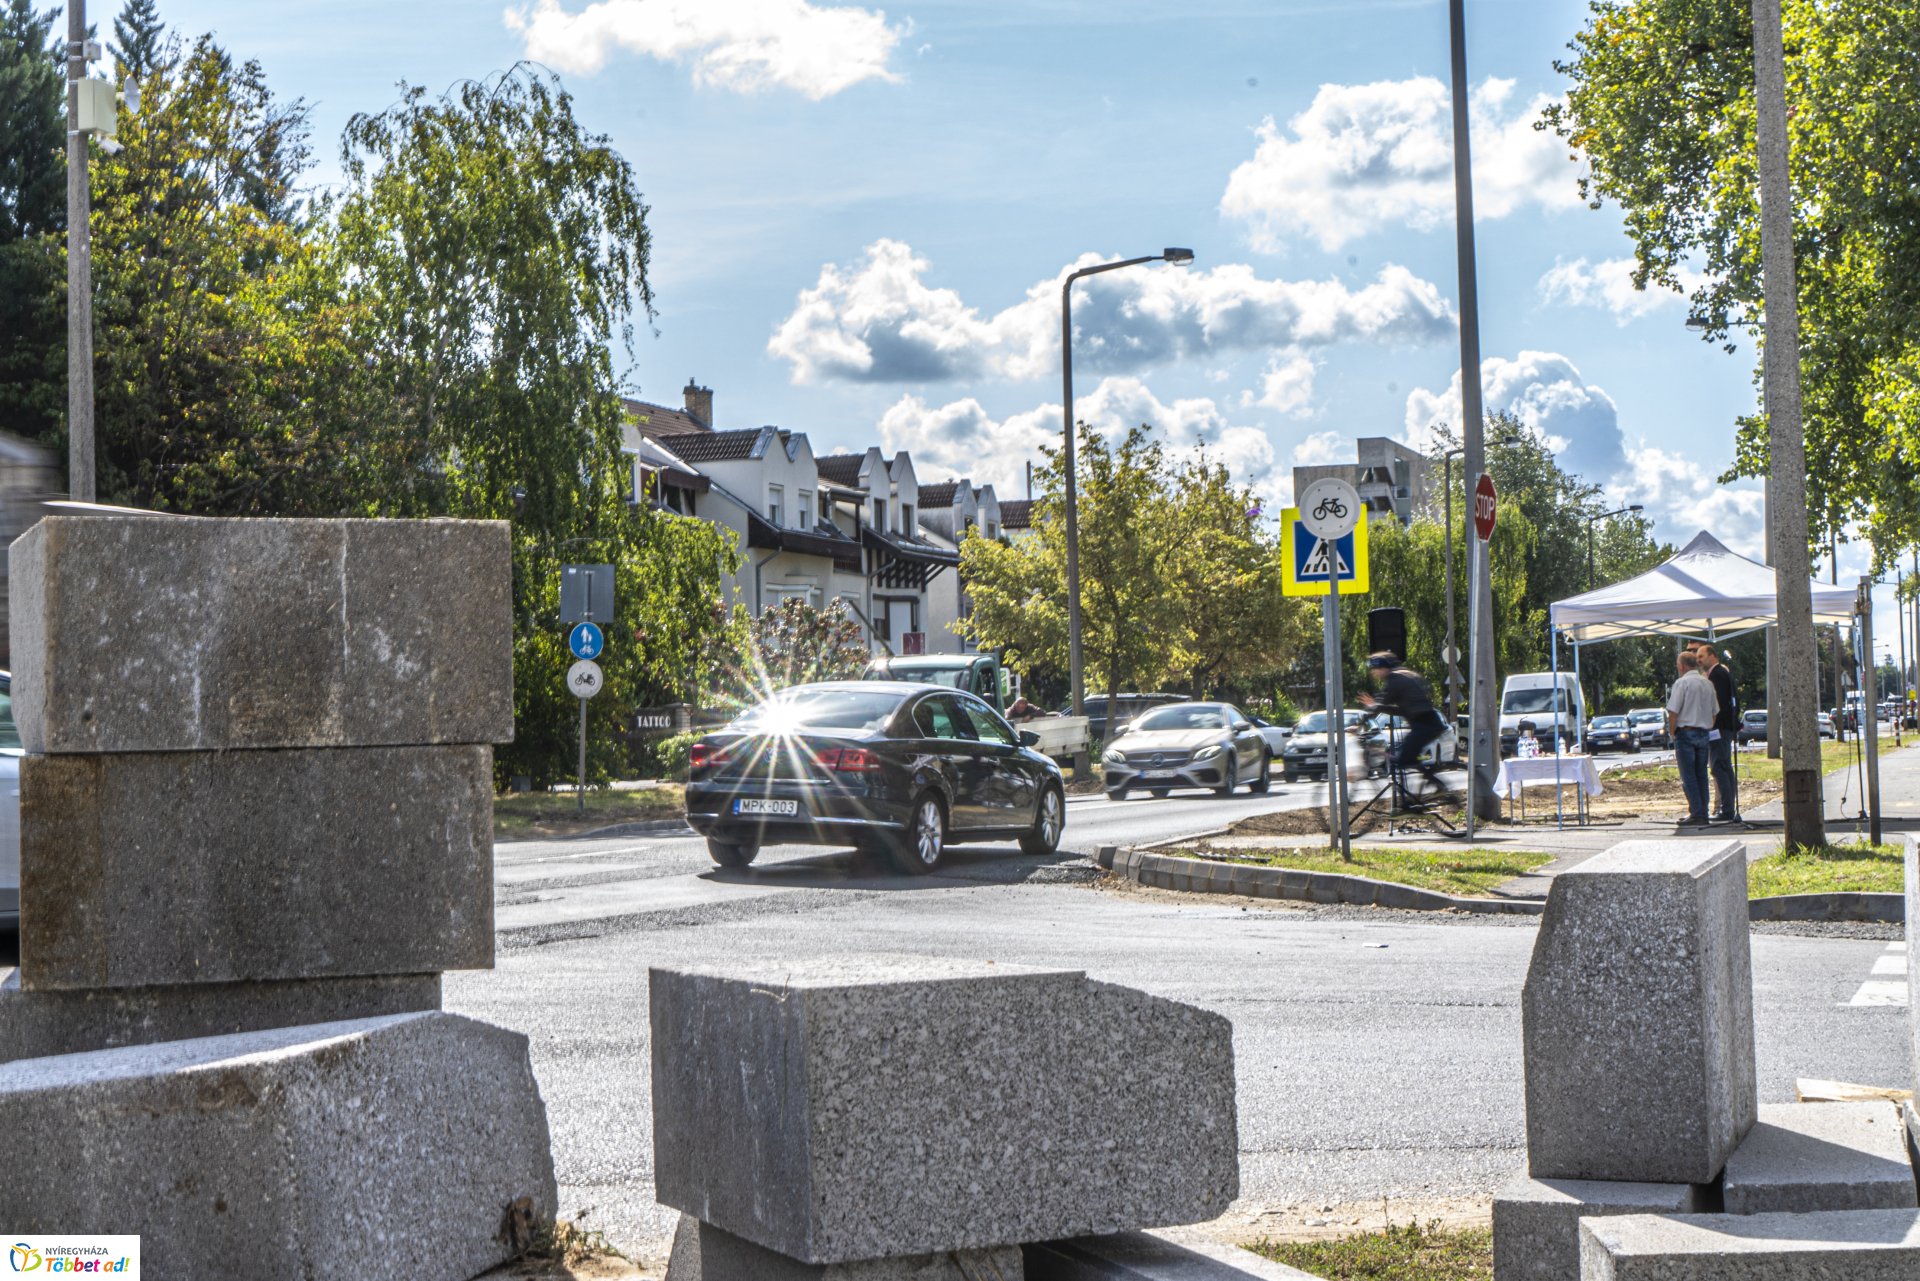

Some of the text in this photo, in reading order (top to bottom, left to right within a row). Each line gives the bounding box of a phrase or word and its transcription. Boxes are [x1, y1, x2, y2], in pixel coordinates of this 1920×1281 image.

[1475, 493, 1495, 520] STOP
[637, 715, 671, 728] TATTOO
[742, 800, 795, 813] MPK-003
